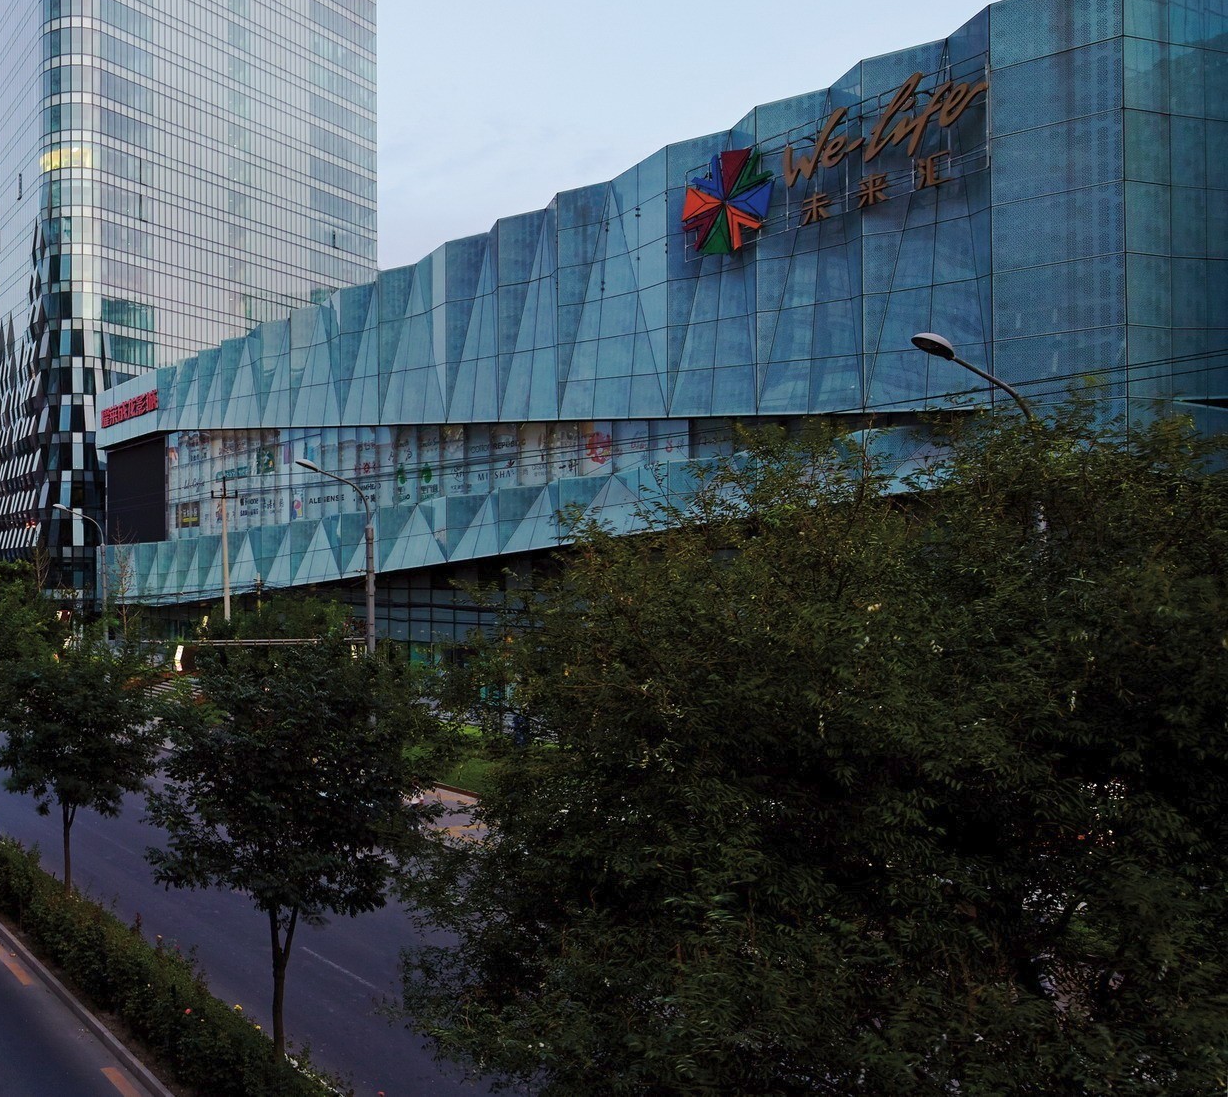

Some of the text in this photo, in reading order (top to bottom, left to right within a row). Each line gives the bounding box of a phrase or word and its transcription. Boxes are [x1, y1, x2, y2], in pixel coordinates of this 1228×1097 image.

[801, 151, 952, 226] 未来汇
[477, 470, 511, 482] MISHA
